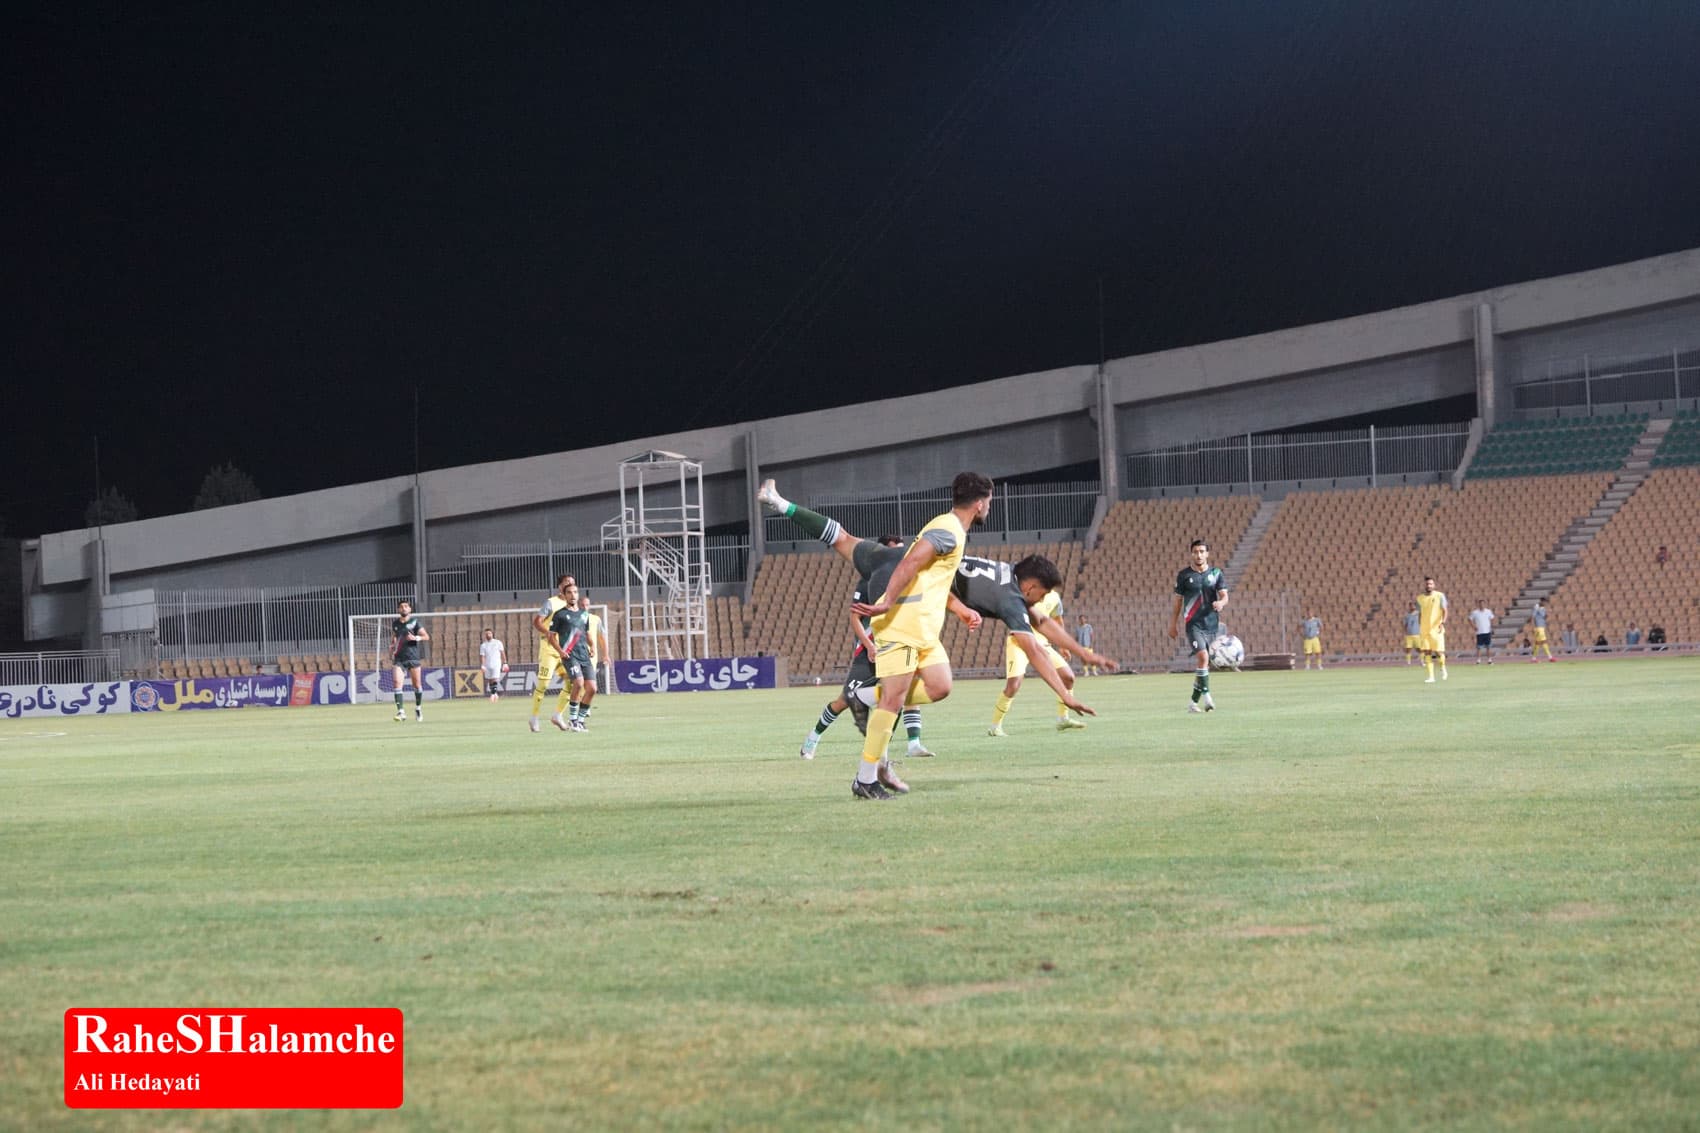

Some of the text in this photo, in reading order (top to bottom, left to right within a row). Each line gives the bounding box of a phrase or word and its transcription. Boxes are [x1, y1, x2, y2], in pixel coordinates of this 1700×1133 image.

[628, 657, 759, 693] چای نادری
[61, 682, 120, 714] کوکی
[158, 680, 214, 711] ملل
